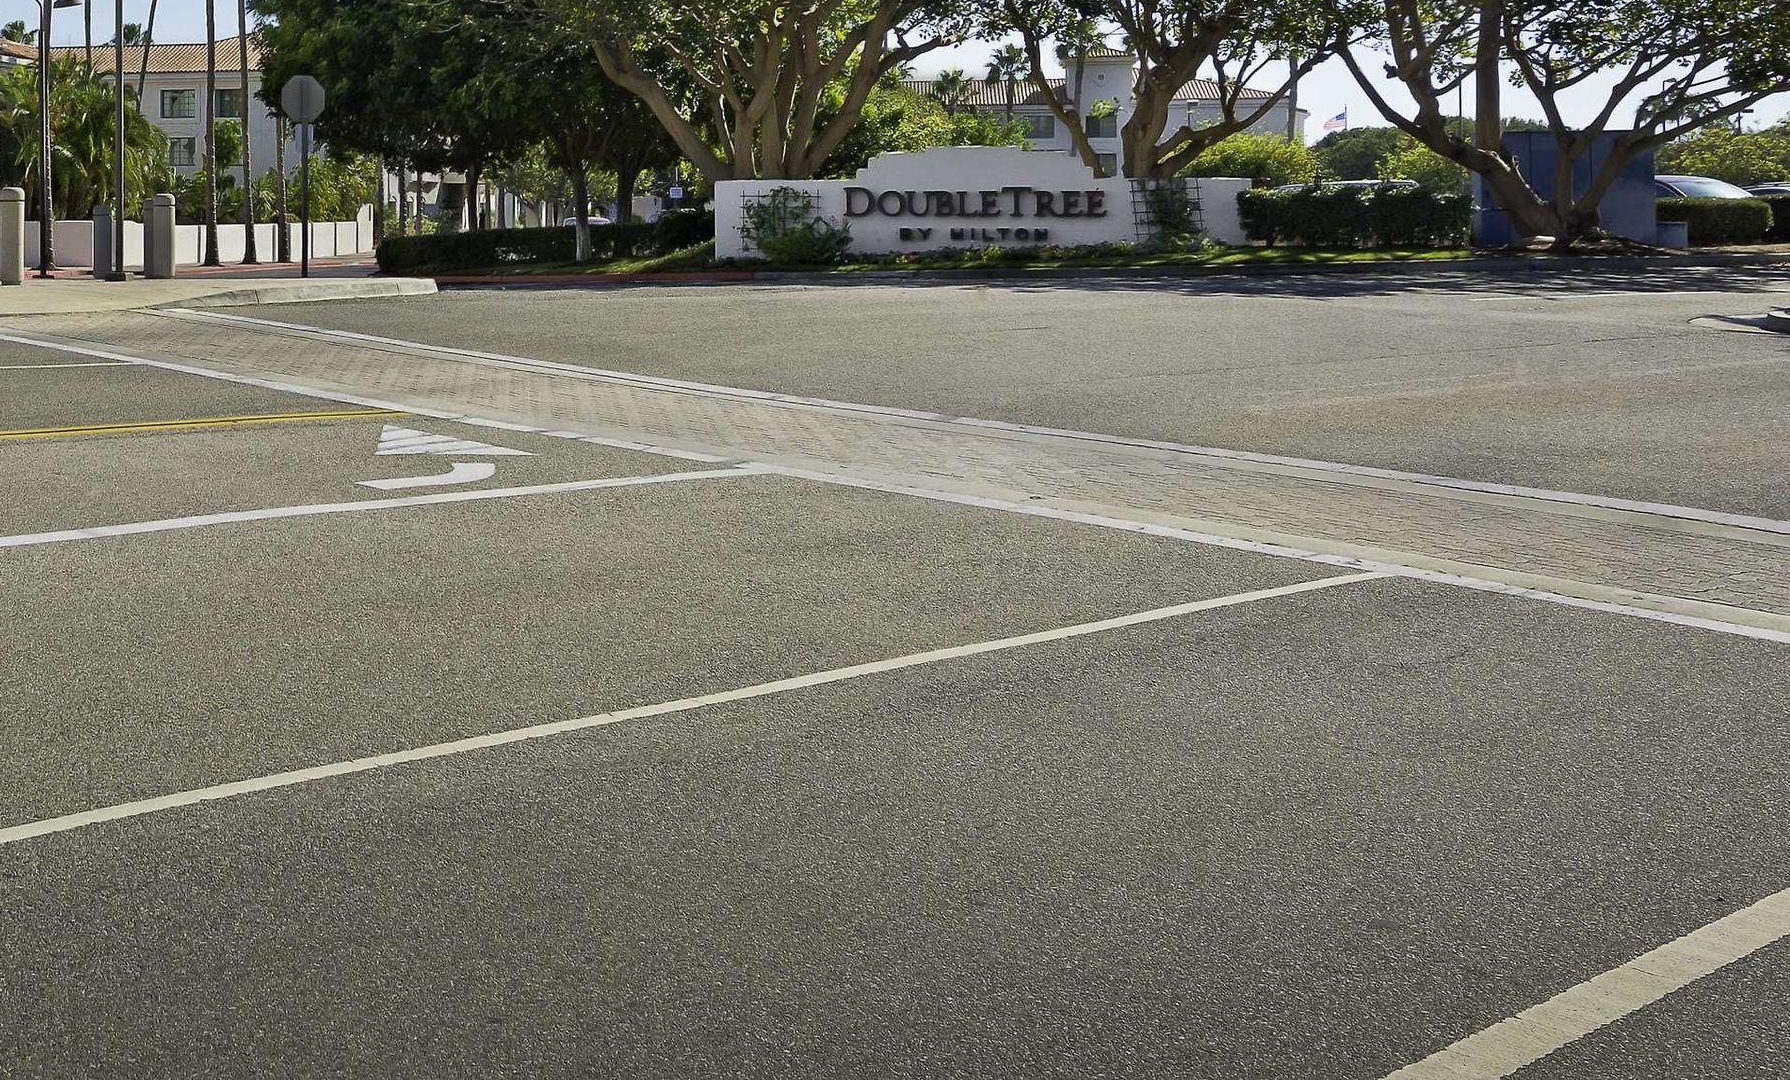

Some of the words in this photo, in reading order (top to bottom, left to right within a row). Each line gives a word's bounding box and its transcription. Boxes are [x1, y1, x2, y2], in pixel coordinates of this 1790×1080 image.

[843, 186, 1108, 218] DOUBLETREE
[898, 227, 932, 242] BY
[949, 227, 1049, 242] HILTON
